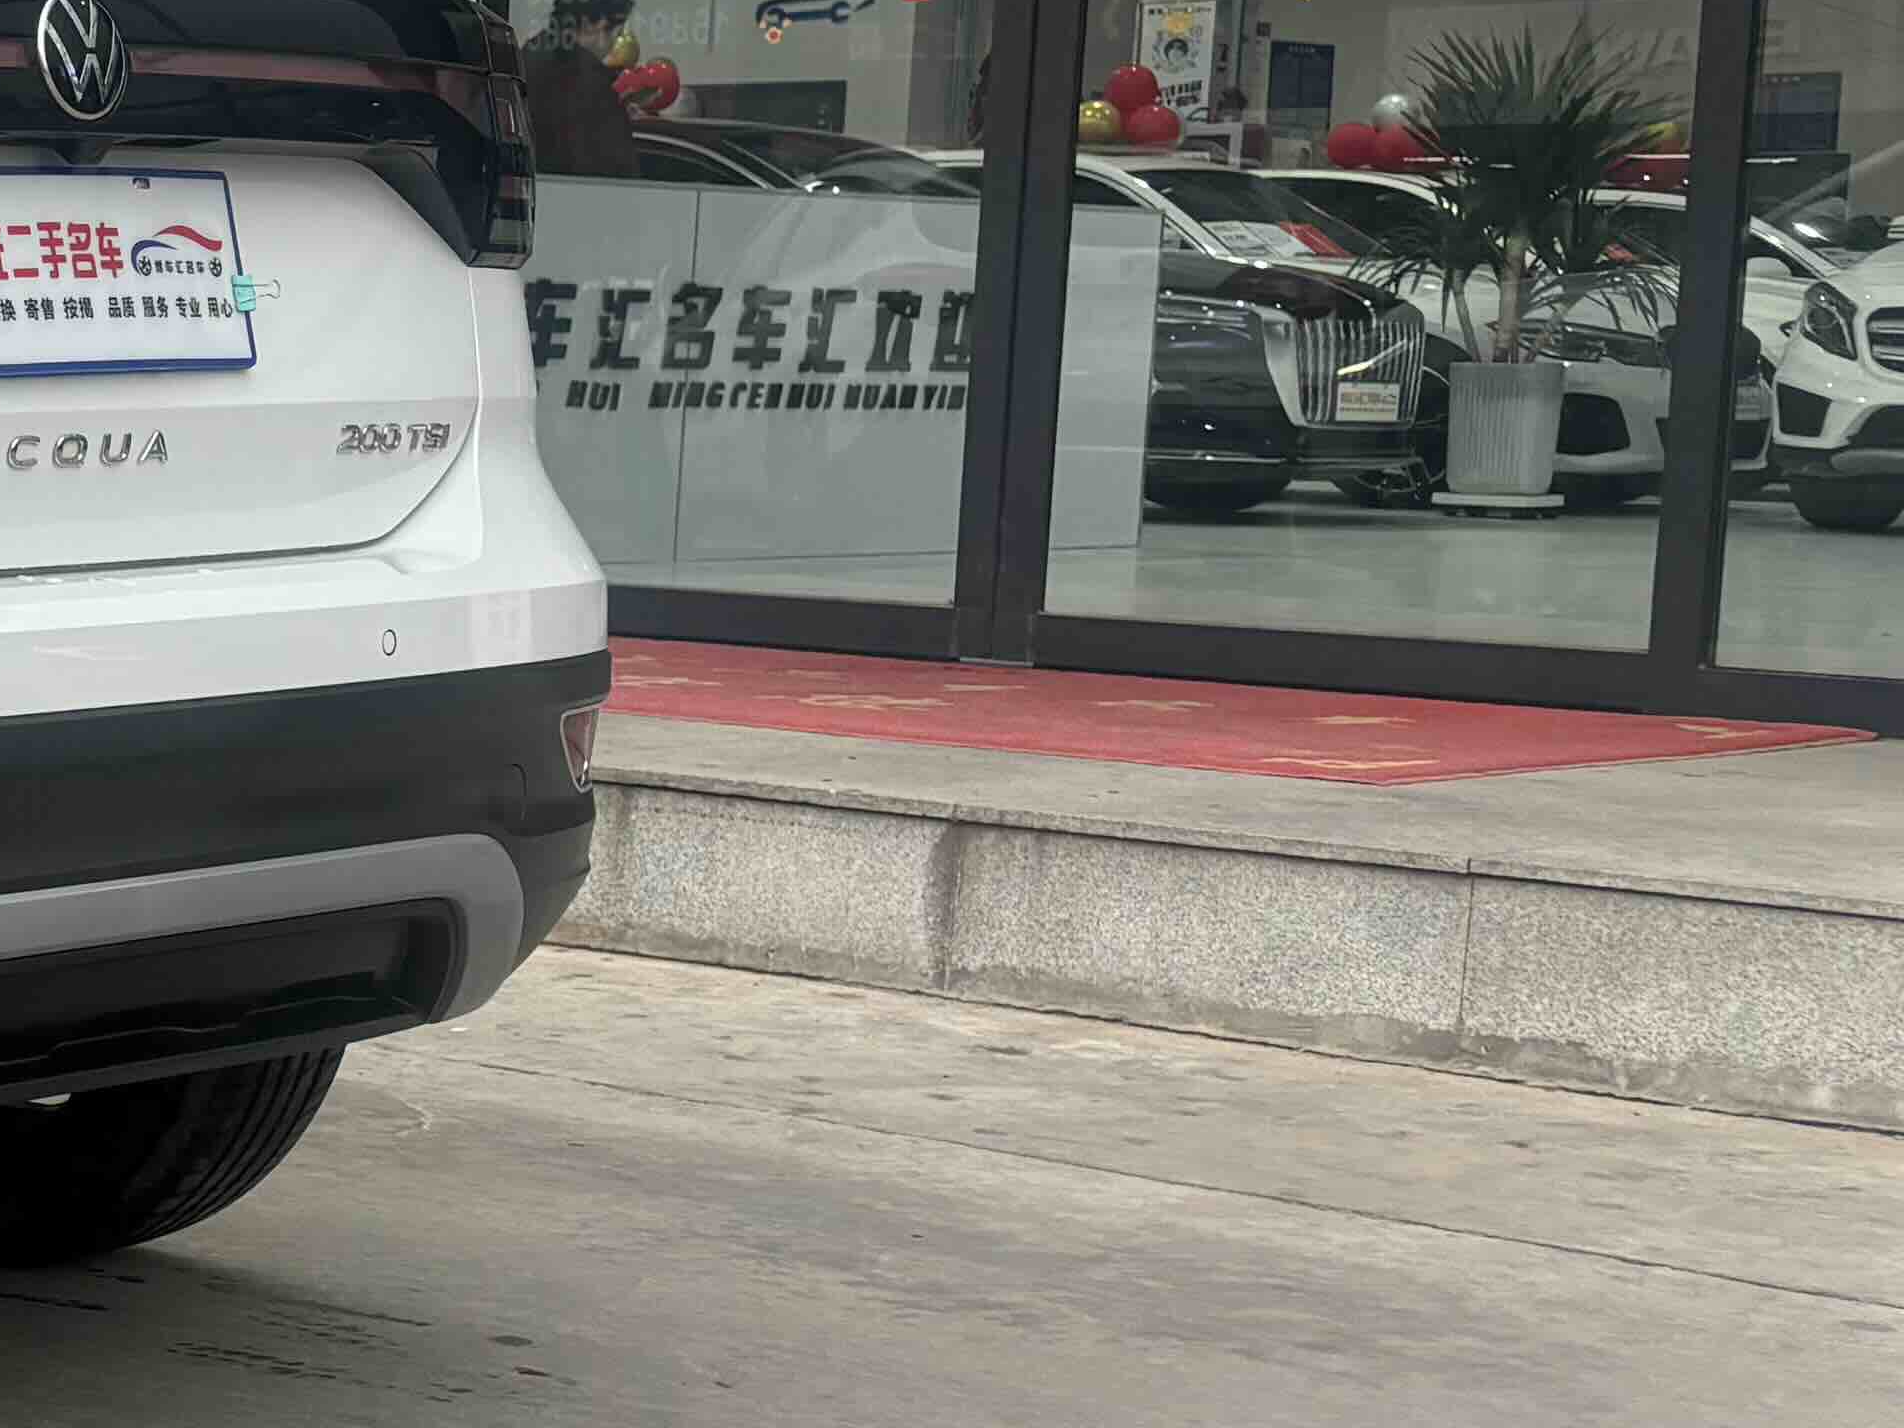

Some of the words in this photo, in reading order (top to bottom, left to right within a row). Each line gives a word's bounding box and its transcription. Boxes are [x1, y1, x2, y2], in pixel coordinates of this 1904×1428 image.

[24, 298, 55, 321] 寄售
[63, 297, 94, 320] 按揭
[108, 296, 137, 319] 品质
[142, 295, 170, 318] 服务
[175, 295, 202, 318] 专业
[207, 295, 233, 318] 用心
